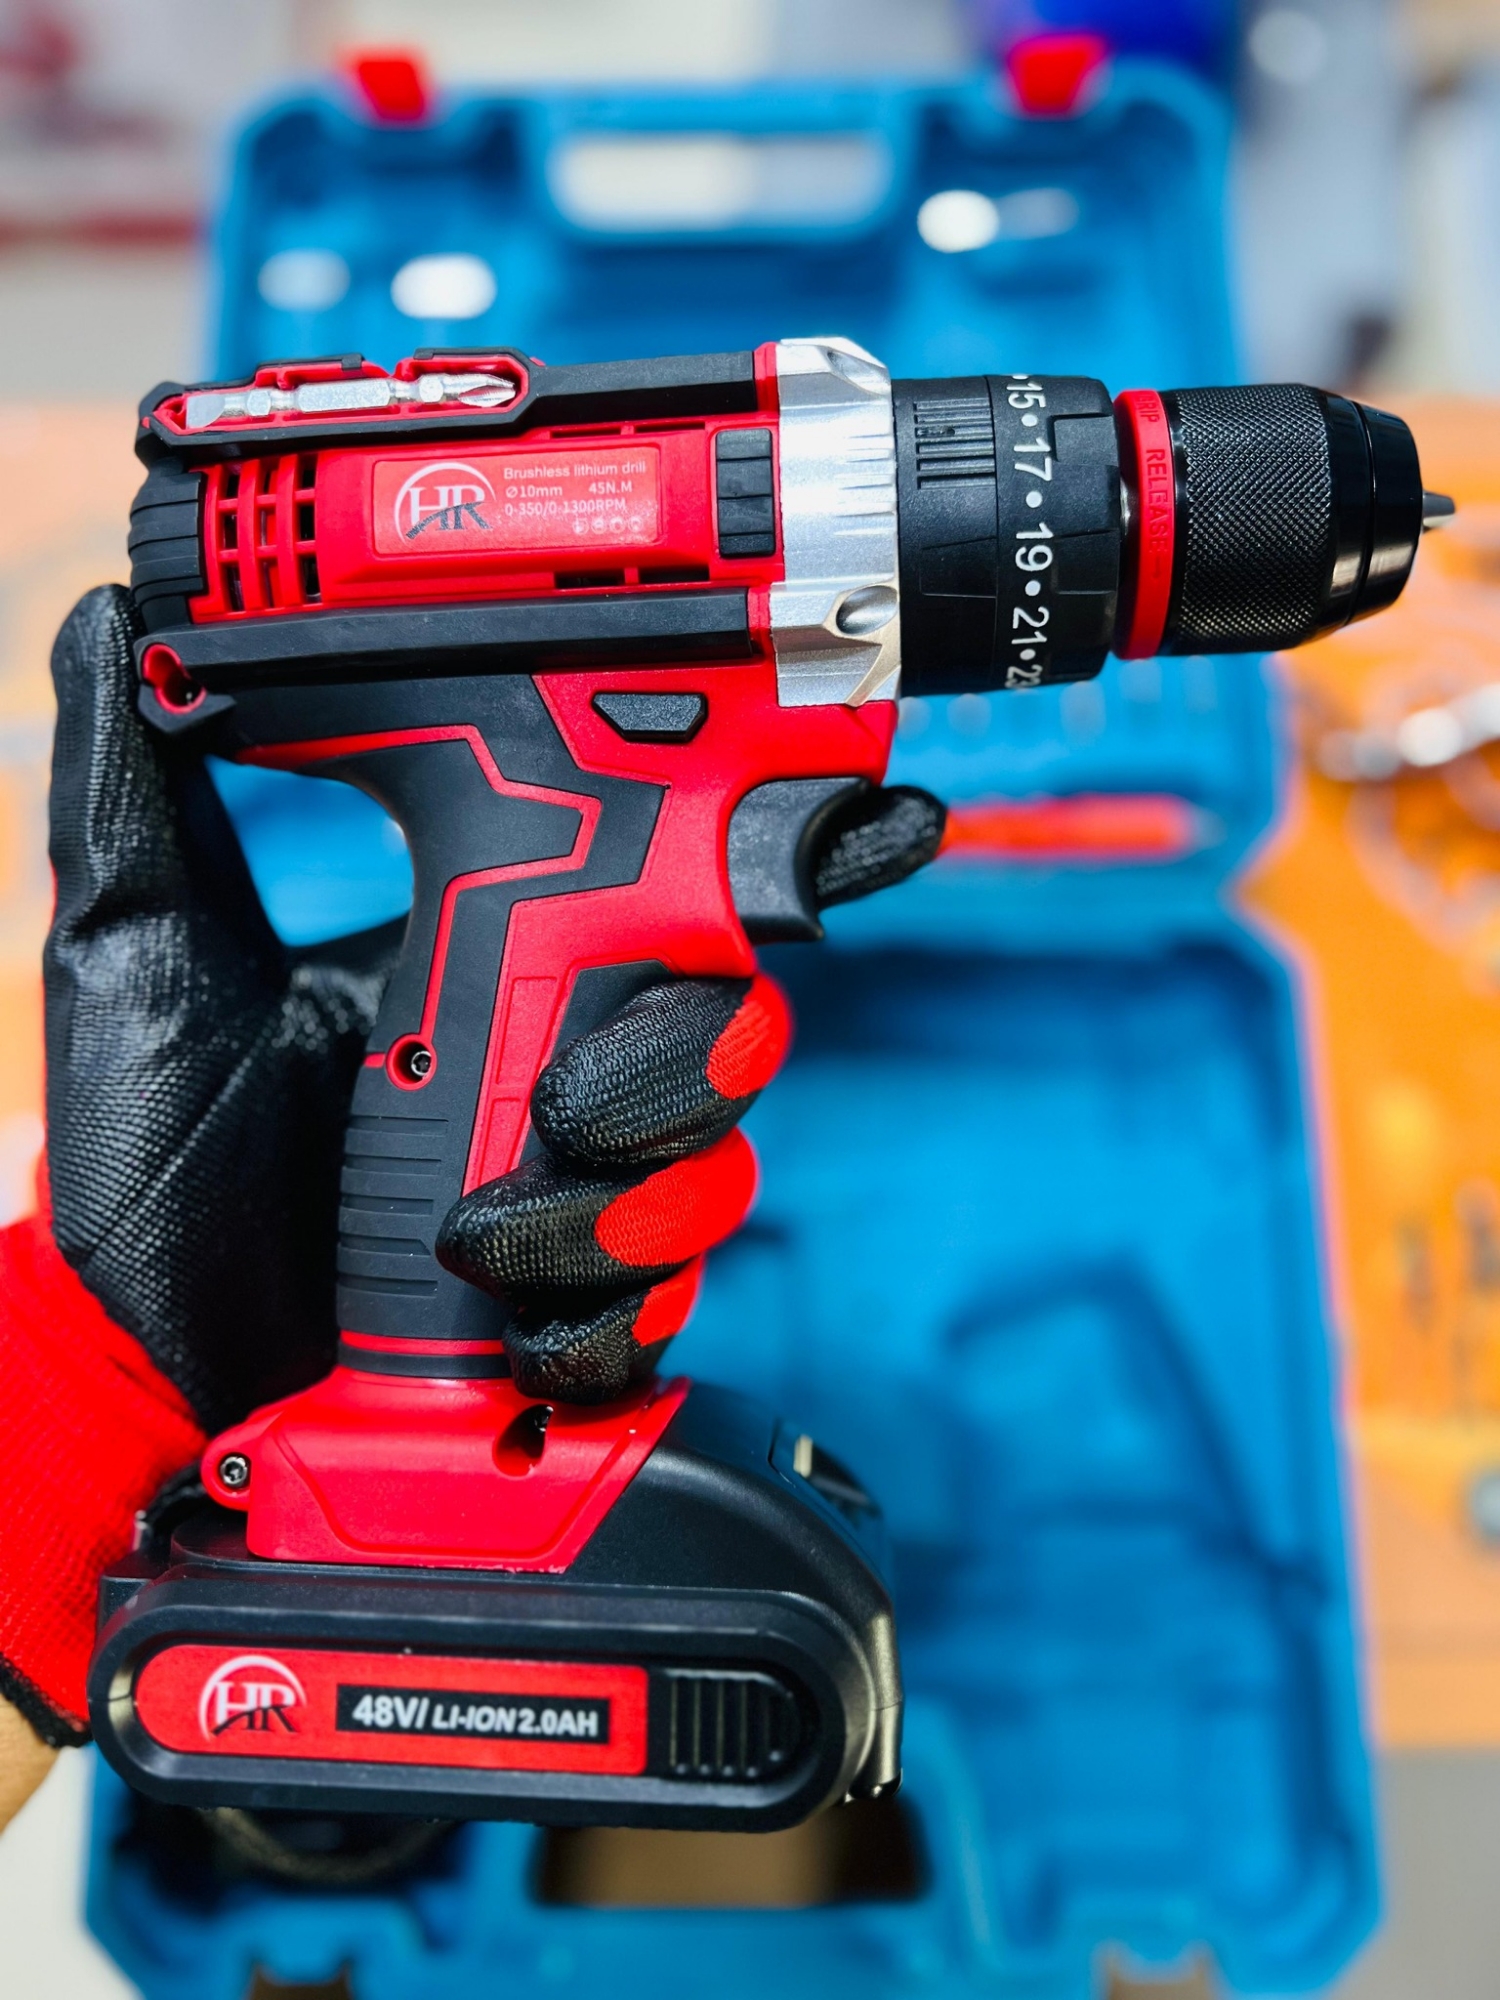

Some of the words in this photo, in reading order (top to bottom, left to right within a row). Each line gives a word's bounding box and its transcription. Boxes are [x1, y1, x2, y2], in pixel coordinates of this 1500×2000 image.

[1006, 382, 1046, 409] 15
[503, 466, 570, 480] Brushless
[573, 463, 618, 477] lithium
[621, 461, 646, 474] drill
[1014, 437, 1053, 482] 17
[588, 480, 633, 495] 45N.M
[1145, 448, 1169, 553] RELEASE
[405, 483, 494, 540] HR
[1015, 522, 1054, 572] 19
[1011, 606, 1050, 645] 21
[212, 1679, 298, 1736] HR
[431, 1704, 516, 1733] LI-ION
[517, 1708, 599, 1737] 2.0AH
